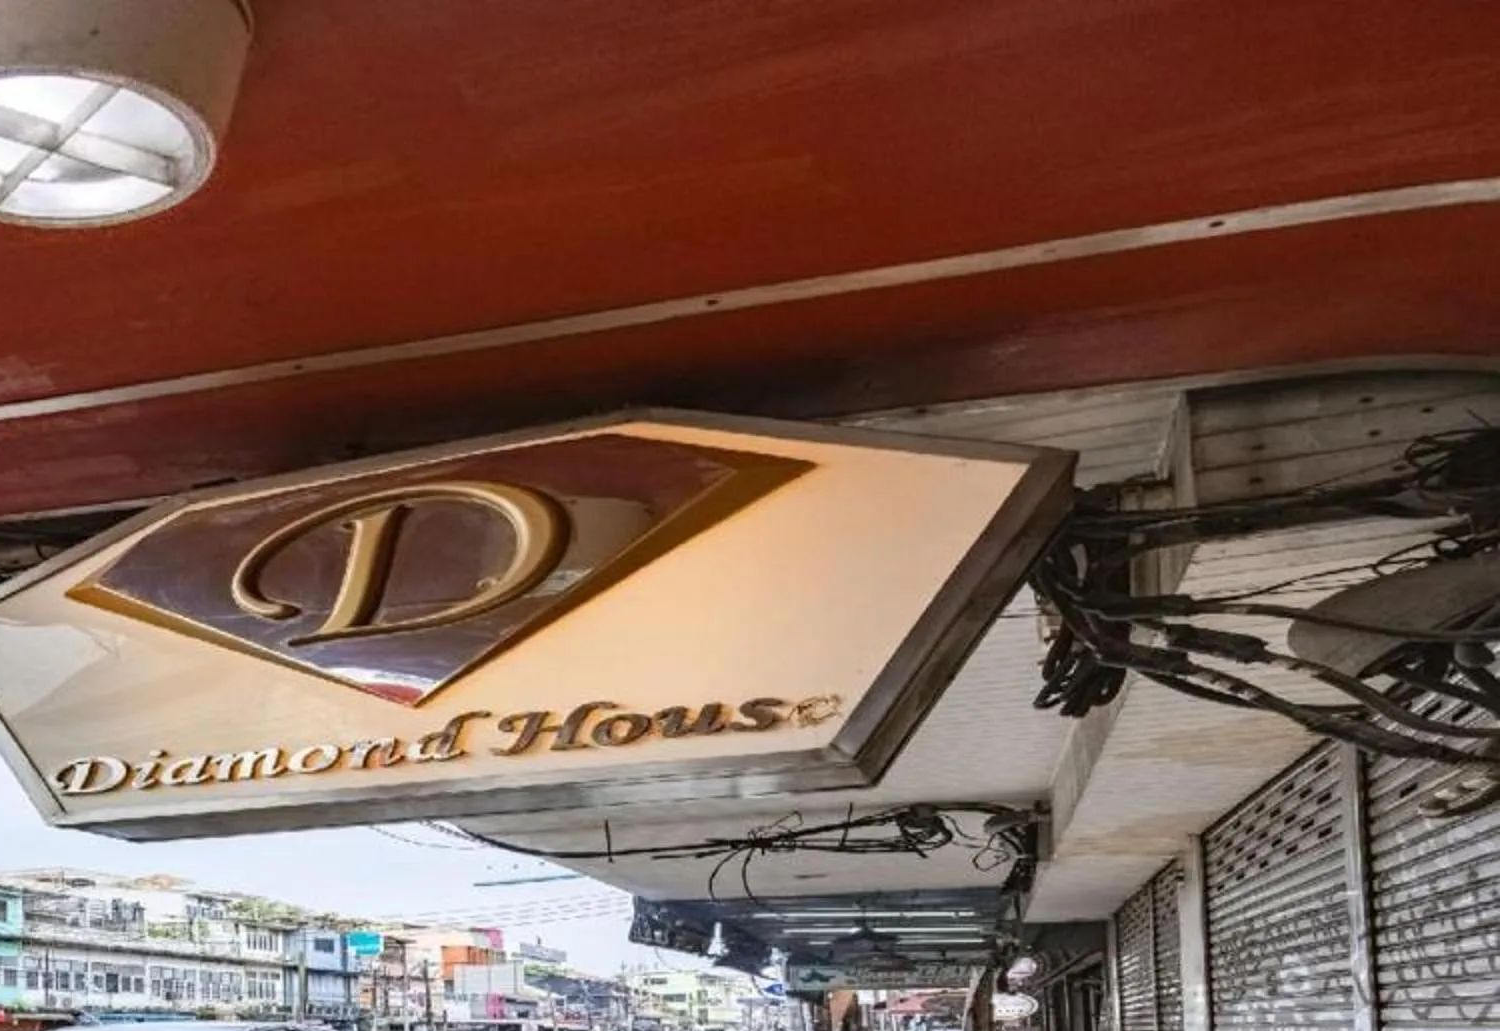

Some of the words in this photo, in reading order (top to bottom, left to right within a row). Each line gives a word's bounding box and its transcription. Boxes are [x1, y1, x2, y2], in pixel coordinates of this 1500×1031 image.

[233, 482, 574, 645] D
[52, 708, 490, 797] Diamond
[494, 693, 844, 758] House
